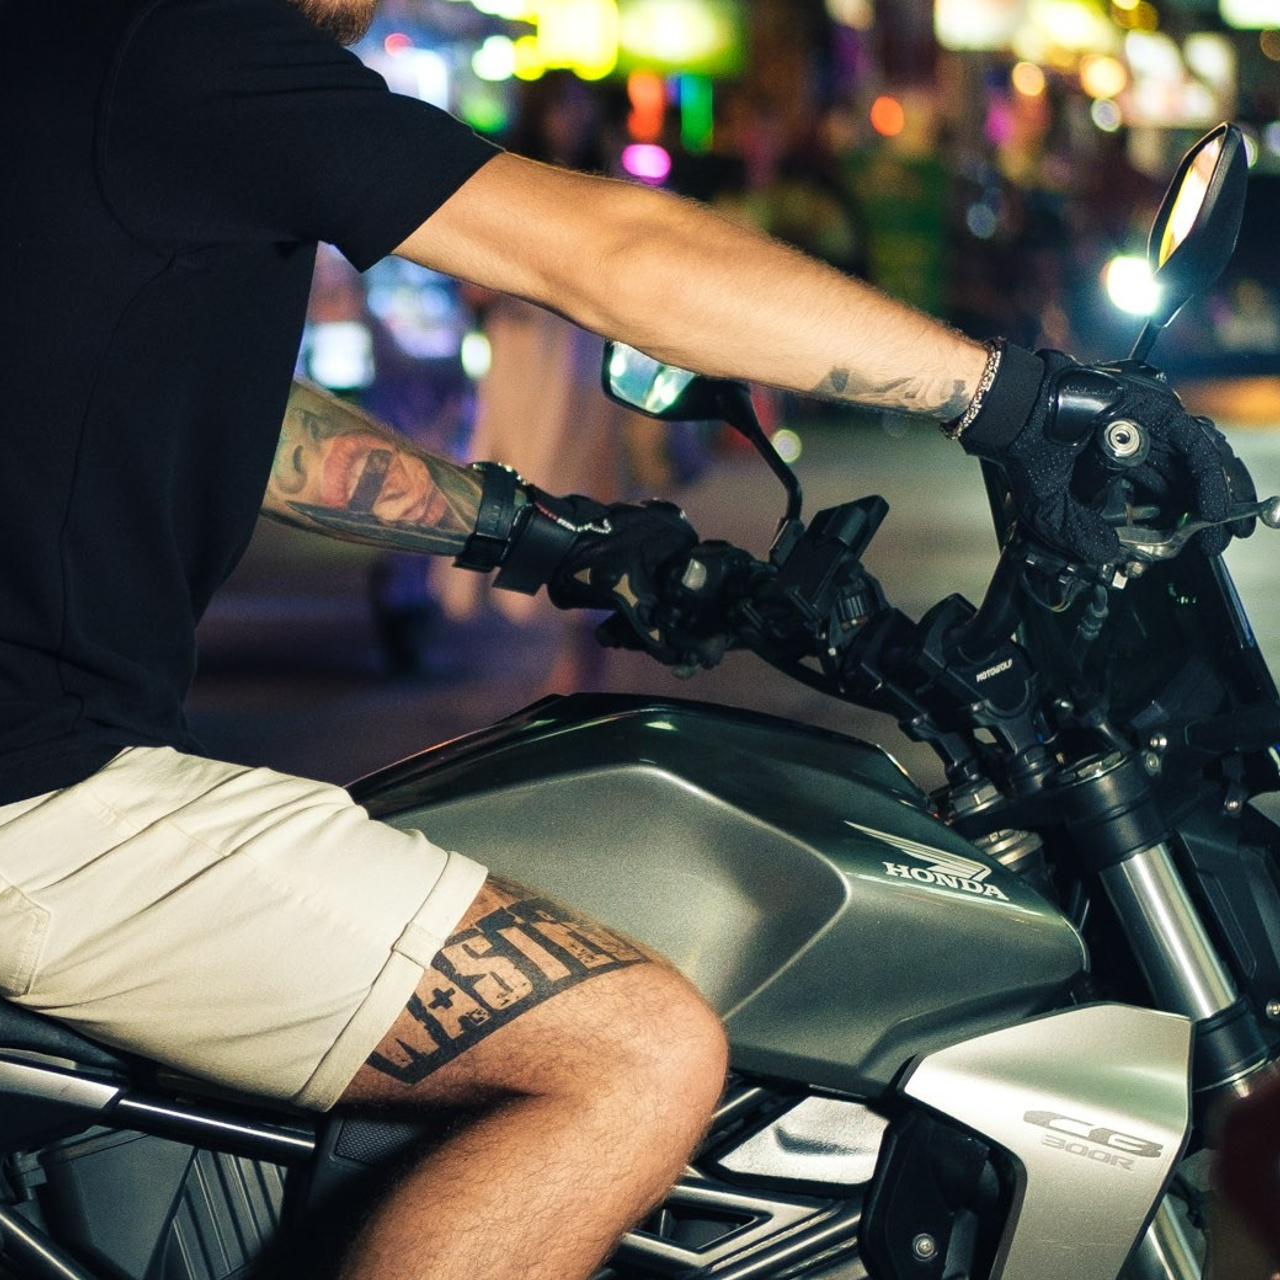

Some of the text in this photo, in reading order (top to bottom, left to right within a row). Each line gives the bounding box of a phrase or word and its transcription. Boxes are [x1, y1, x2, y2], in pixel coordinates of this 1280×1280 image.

[882, 861, 1010, 901] HONDA
[1022, 1110, 1164, 1159] CB
[1041, 1133, 1135, 1172] 300R
